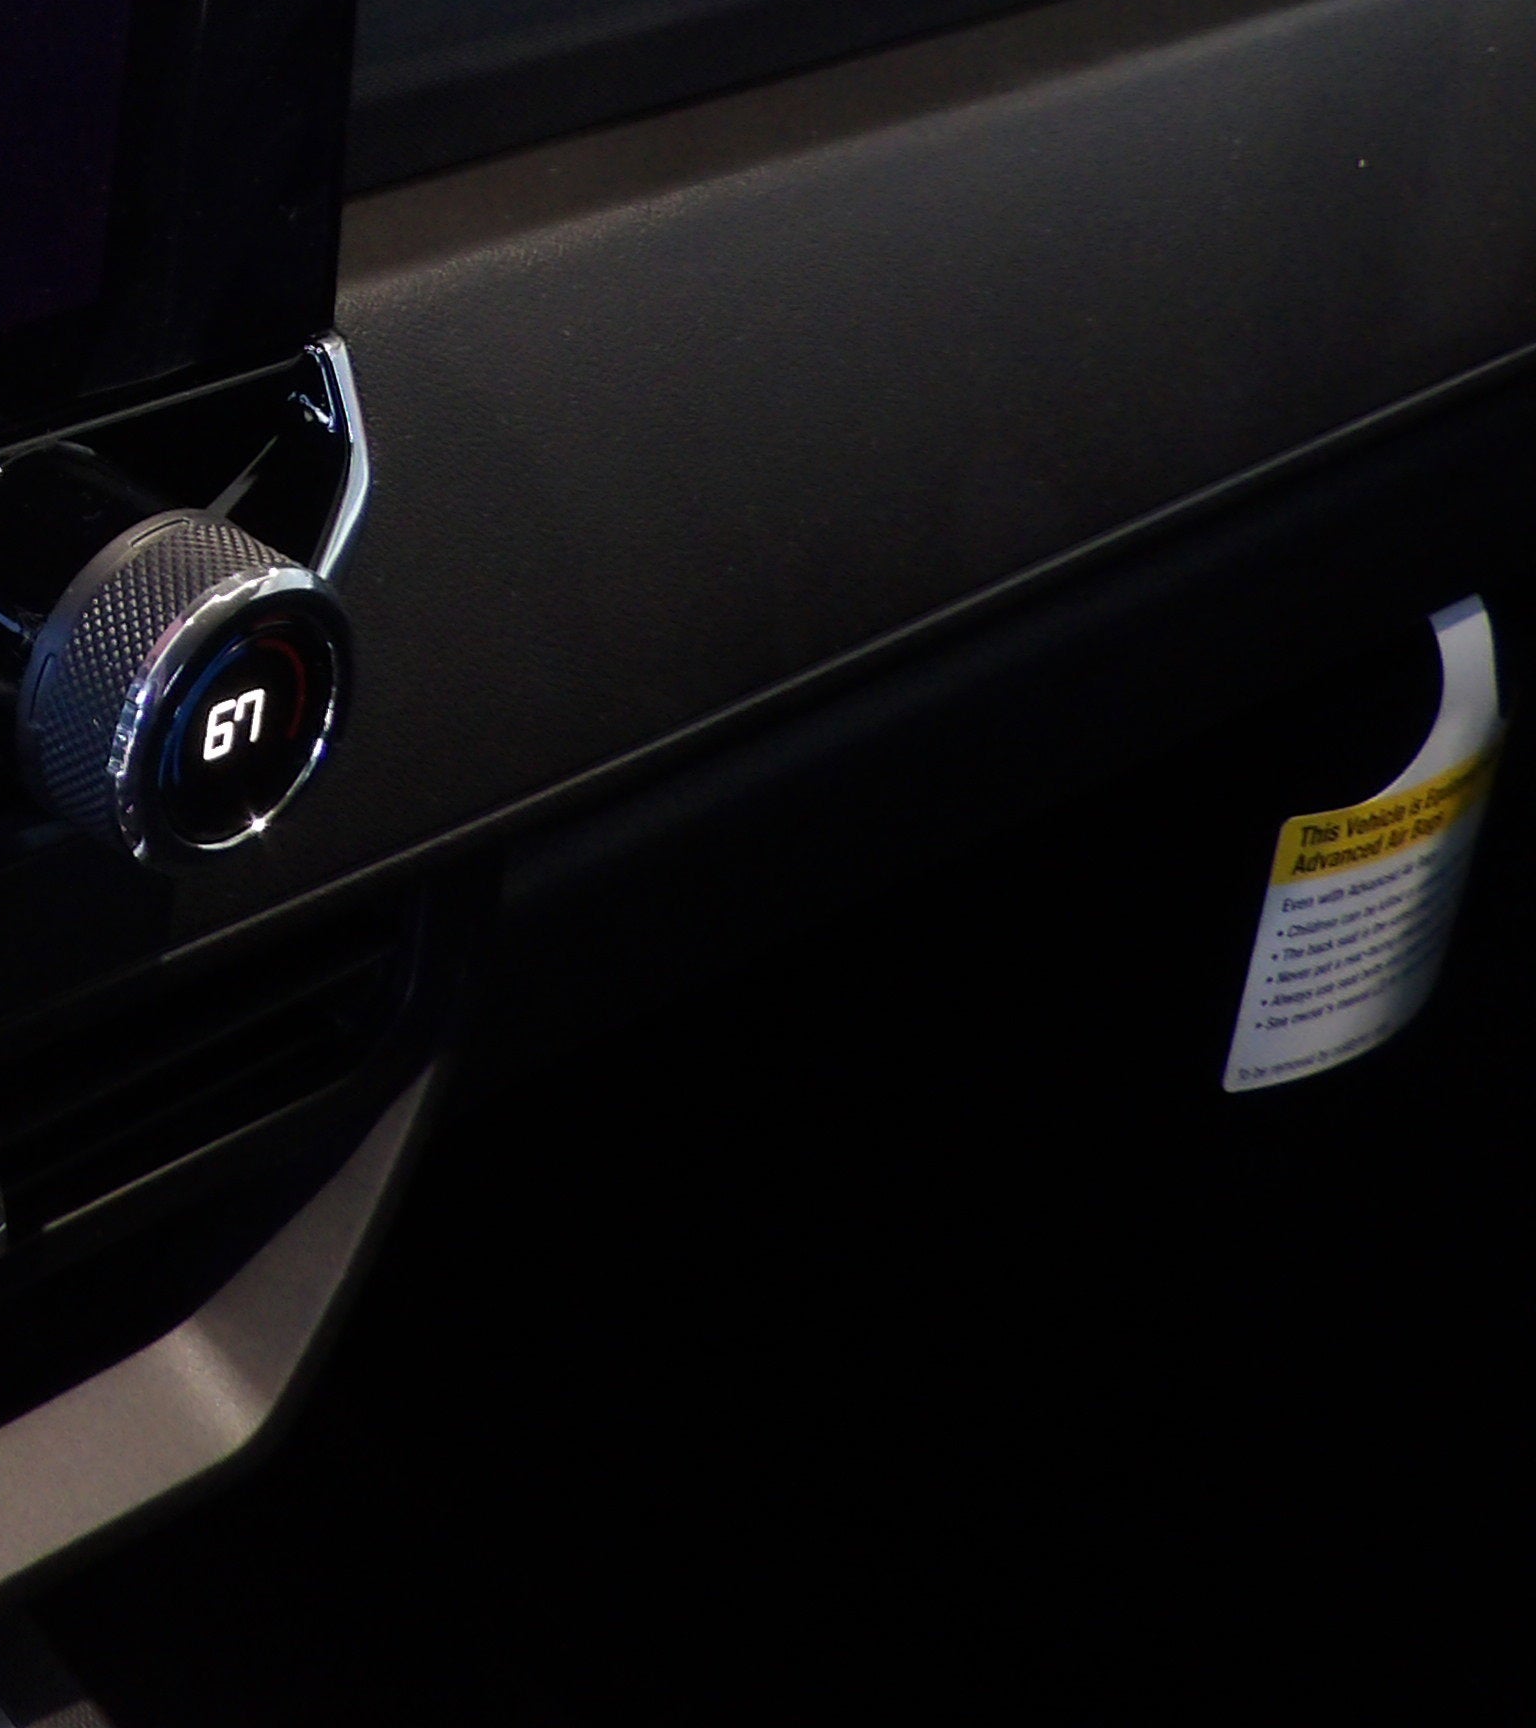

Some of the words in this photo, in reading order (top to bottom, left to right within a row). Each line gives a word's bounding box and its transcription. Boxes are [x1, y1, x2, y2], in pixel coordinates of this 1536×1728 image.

[202, 688, 266, 761] 67
[1301, 823, 1341, 848] This
[1346, 804, 1407, 838] Vehicle
[1292, 835, 1384, 875] Advanced
